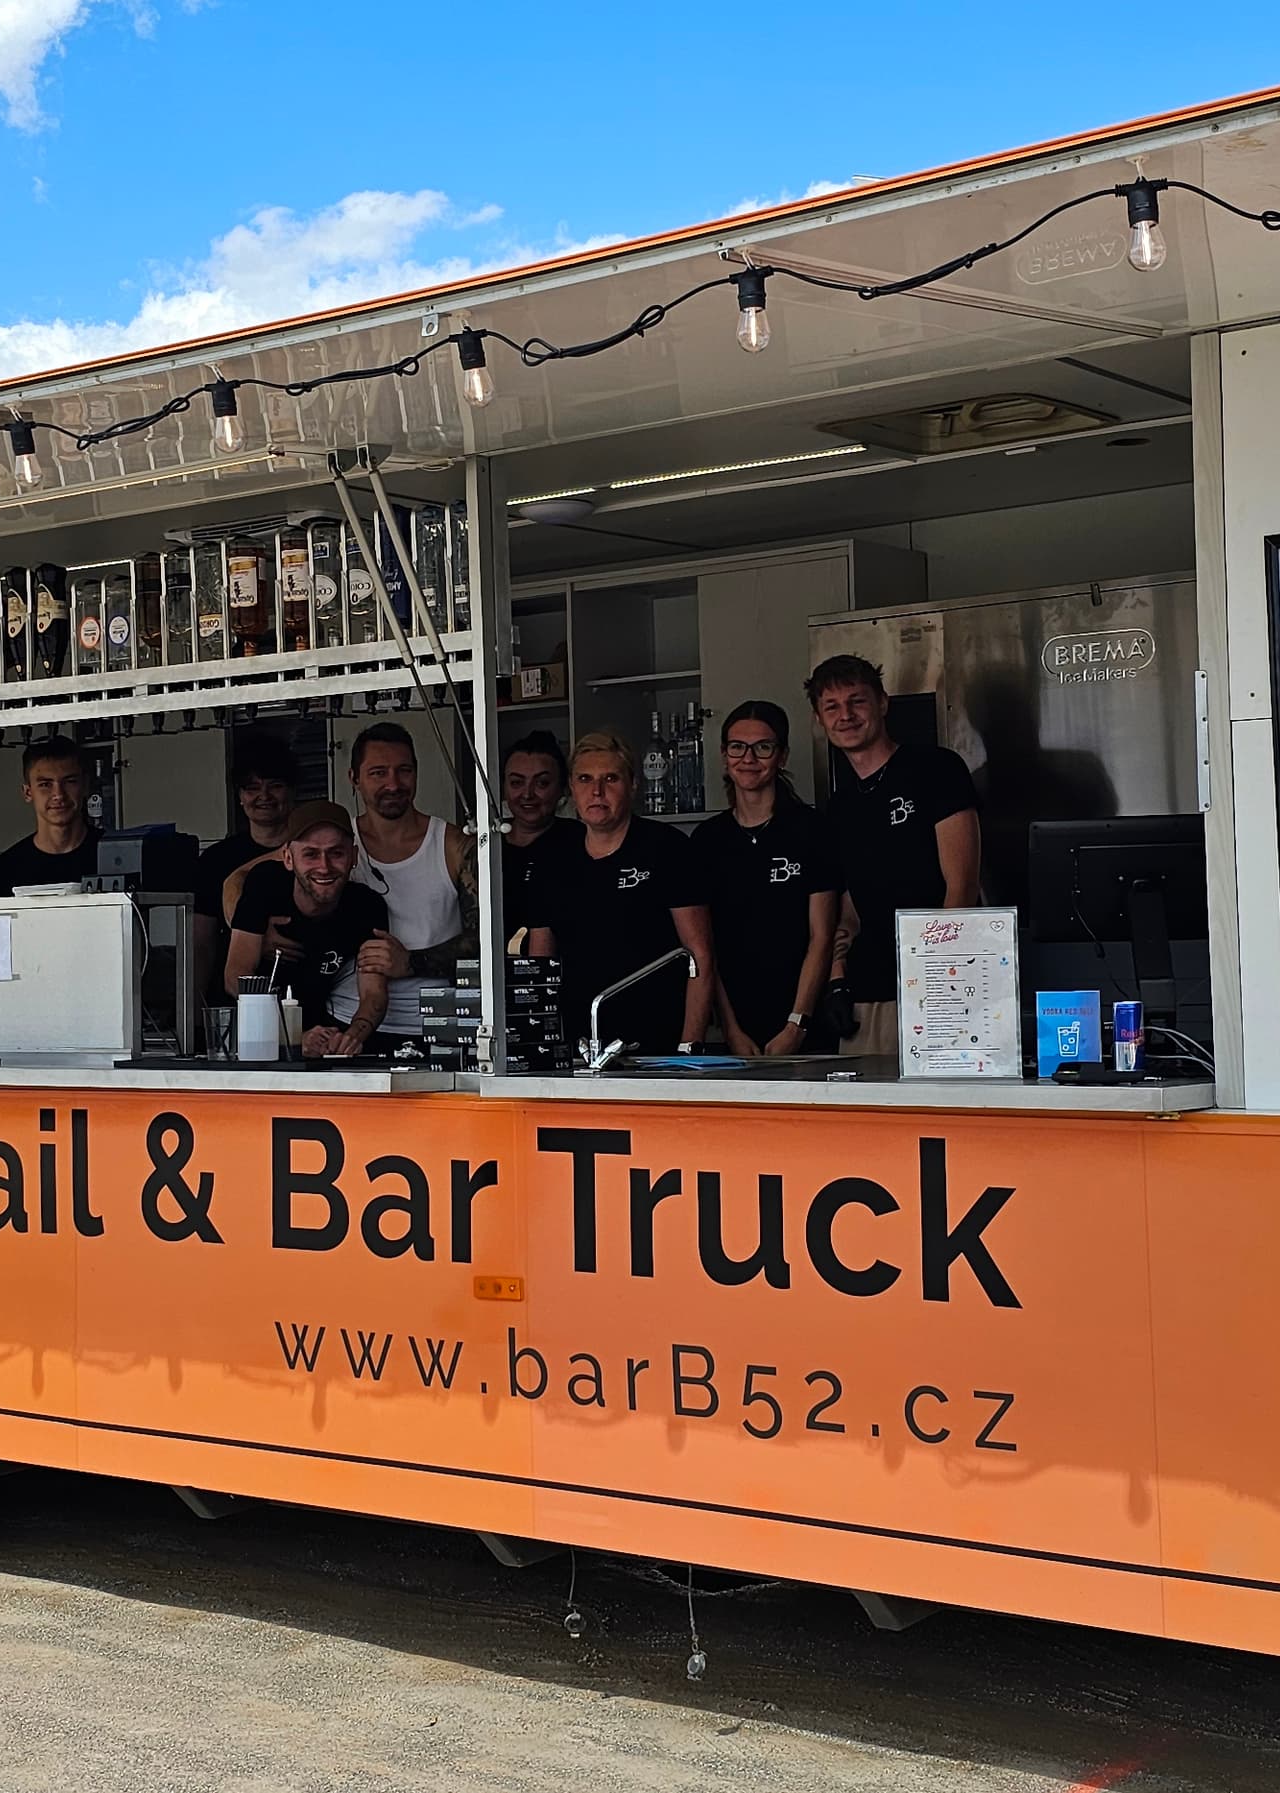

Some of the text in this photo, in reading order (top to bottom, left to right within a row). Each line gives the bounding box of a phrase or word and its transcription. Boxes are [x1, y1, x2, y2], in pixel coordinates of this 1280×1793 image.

[1055, 637, 1144, 666] BREMA
[1057, 667, 1137, 684] IceMakers
[141, 1112, 225, 1245] &
[271, 1117, 499, 1264] Bar
[537, 1127, 1023, 1309] Truck
[274, 1321, 1017, 1452] www.barB52.cz
